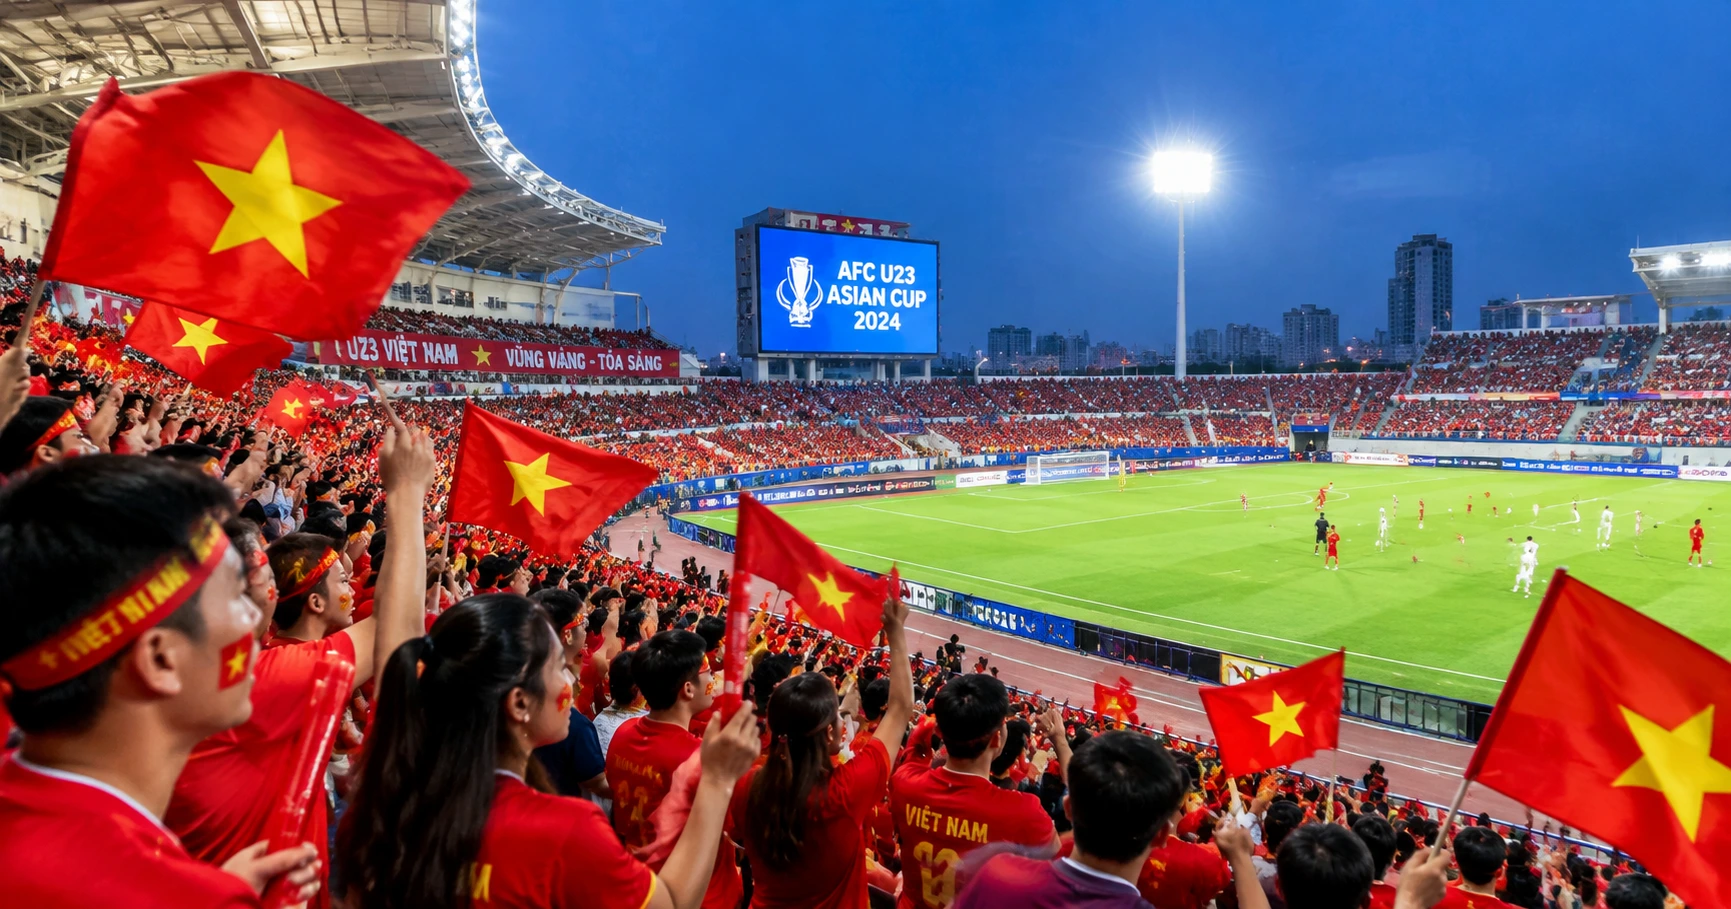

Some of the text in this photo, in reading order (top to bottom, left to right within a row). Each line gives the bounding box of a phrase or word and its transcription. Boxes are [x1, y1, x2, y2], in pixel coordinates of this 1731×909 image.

[837, 260, 916, 285] AFC U23
[826, 284, 927, 308] ASIAN CUP
[853, 311, 902, 331] 2024
[381, 334, 418, 366] VIỆT
[422, 341, 459, 364] NAM
[945, 816, 988, 844] NAM
